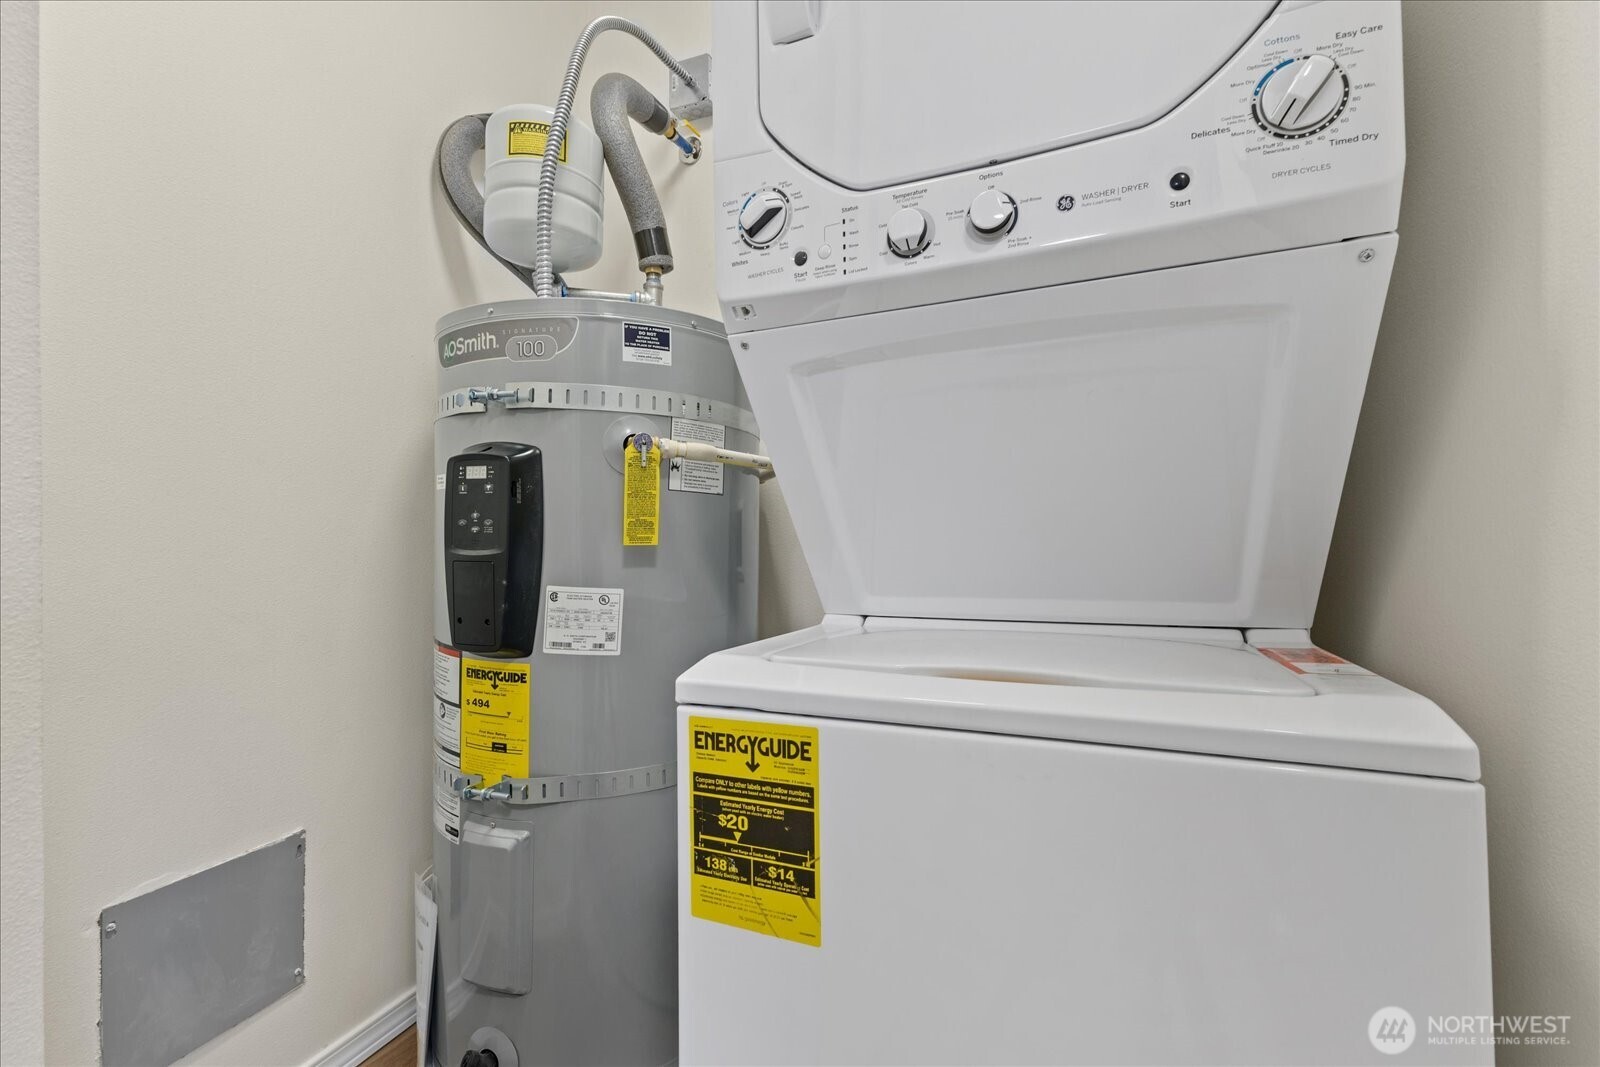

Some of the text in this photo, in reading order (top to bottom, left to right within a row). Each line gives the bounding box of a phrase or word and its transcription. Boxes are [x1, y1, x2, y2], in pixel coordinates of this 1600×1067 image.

[1336, 24, 1383, 39] Easy Care
[1264, 34, 1300, 46] Cottons
[1191, 127, 1230, 140] Delicates
[1329, 133, 1379, 146] Timed Dry
[978, 171, 1003, 181] Options
[1272, 163, 1331, 179] DRYER CYCLES
[892, 189, 927, 200] Temperature
[1081, 182, 1149, 201] WASHER DRYER
[1170, 199, 1191, 208] Start
[767, 267, 784, 275] CYCLES
[794, 271, 808, 279] Start
[502, 326, 561, 335] SIGNATURE
[517, 340, 545, 357] 100
[466, 667, 527, 684] ENERGYGUIDE
[472, 698, 490, 708] 494
[694, 730, 812, 762] ENERGYGUIDE
[716, 778, 728, 786] ONLY
[757, 806, 772, 814] Energy
[718, 814, 748, 831] $20
[704, 857, 727, 871] 138
[768, 866, 795, 882] $14
